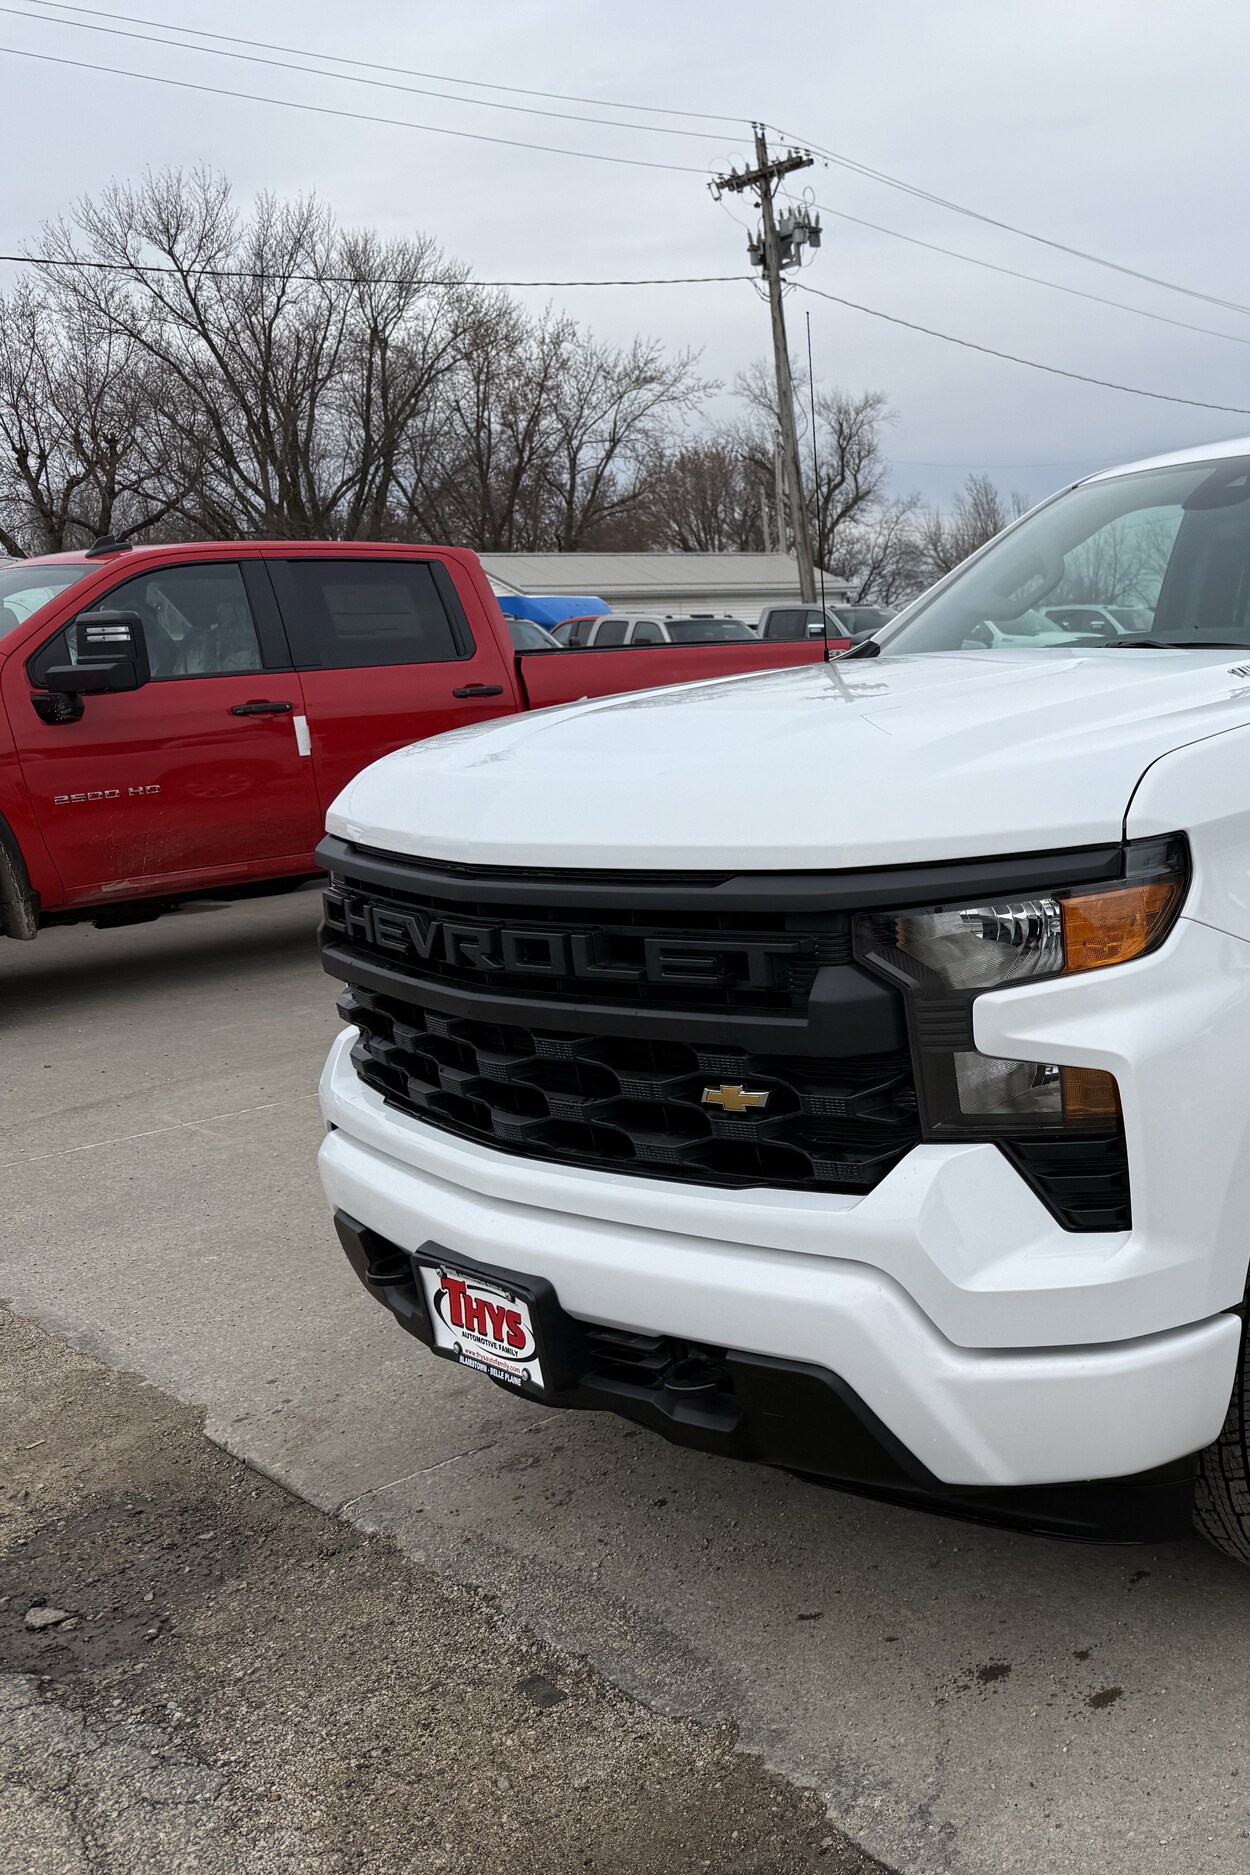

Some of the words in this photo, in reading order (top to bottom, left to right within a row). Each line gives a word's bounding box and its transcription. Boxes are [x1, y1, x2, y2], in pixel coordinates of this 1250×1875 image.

[54, 789, 120, 804] 2500
[128, 784, 160, 796] HD
[322, 890, 812, 986] CHEVROLET
[440, 1278, 526, 1349] THYS
[461, 1331, 498, 1350] AUTOMOTIVE
[498, 1344, 518, 1357] FAMILY
[489, 1367, 505, 1380] BELLE
